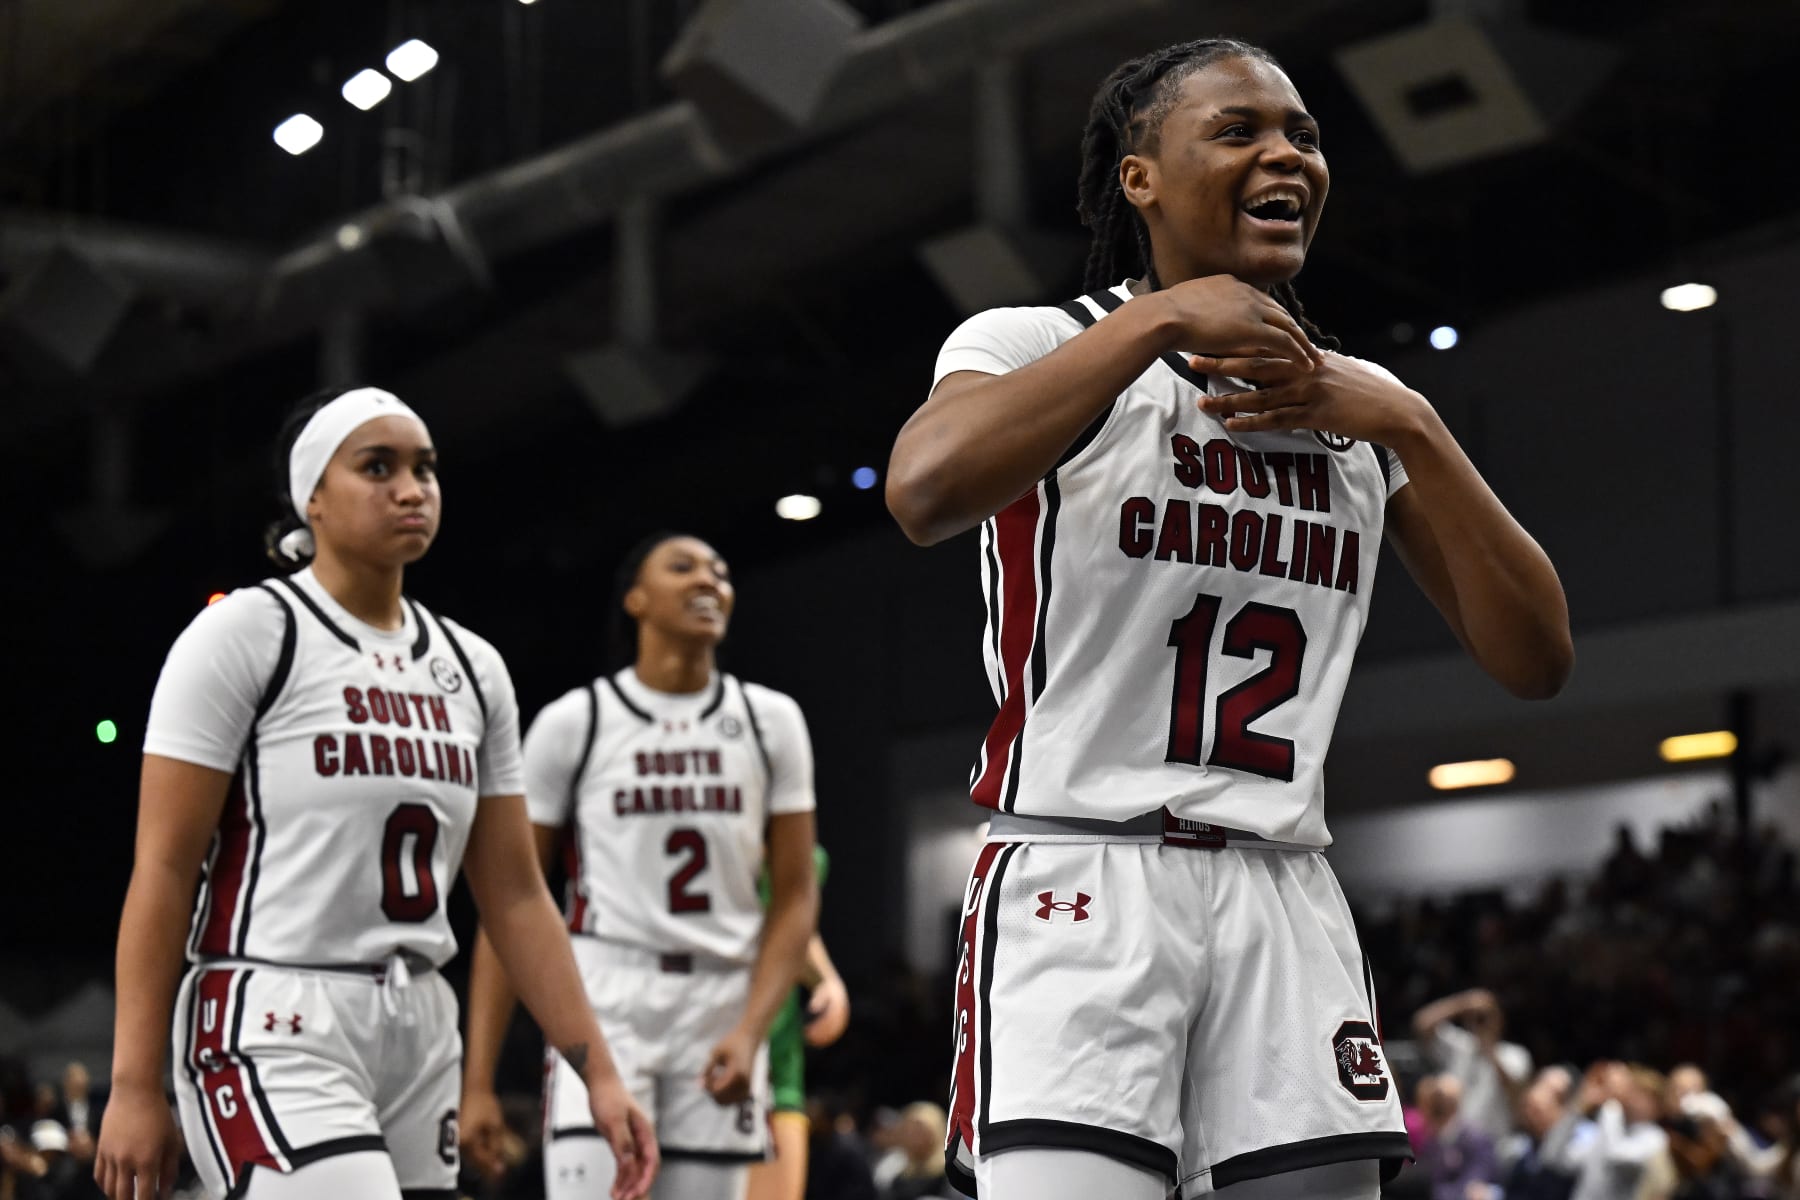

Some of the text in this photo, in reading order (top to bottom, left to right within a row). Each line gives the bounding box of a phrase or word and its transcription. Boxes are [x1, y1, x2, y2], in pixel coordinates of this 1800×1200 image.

[1171, 433, 1331, 513] SOUTH
[1119, 496, 1360, 595] CAROLINA
[343, 685, 452, 734] SOUTH
[1164, 593, 1308, 782] 12
[314, 733, 474, 789] CAROLINA
[614, 785, 743, 816] CAROLINA
[635, 750, 722, 777] SOUTH
[381, 803, 439, 923] 0
[665, 827, 711, 915] 2
